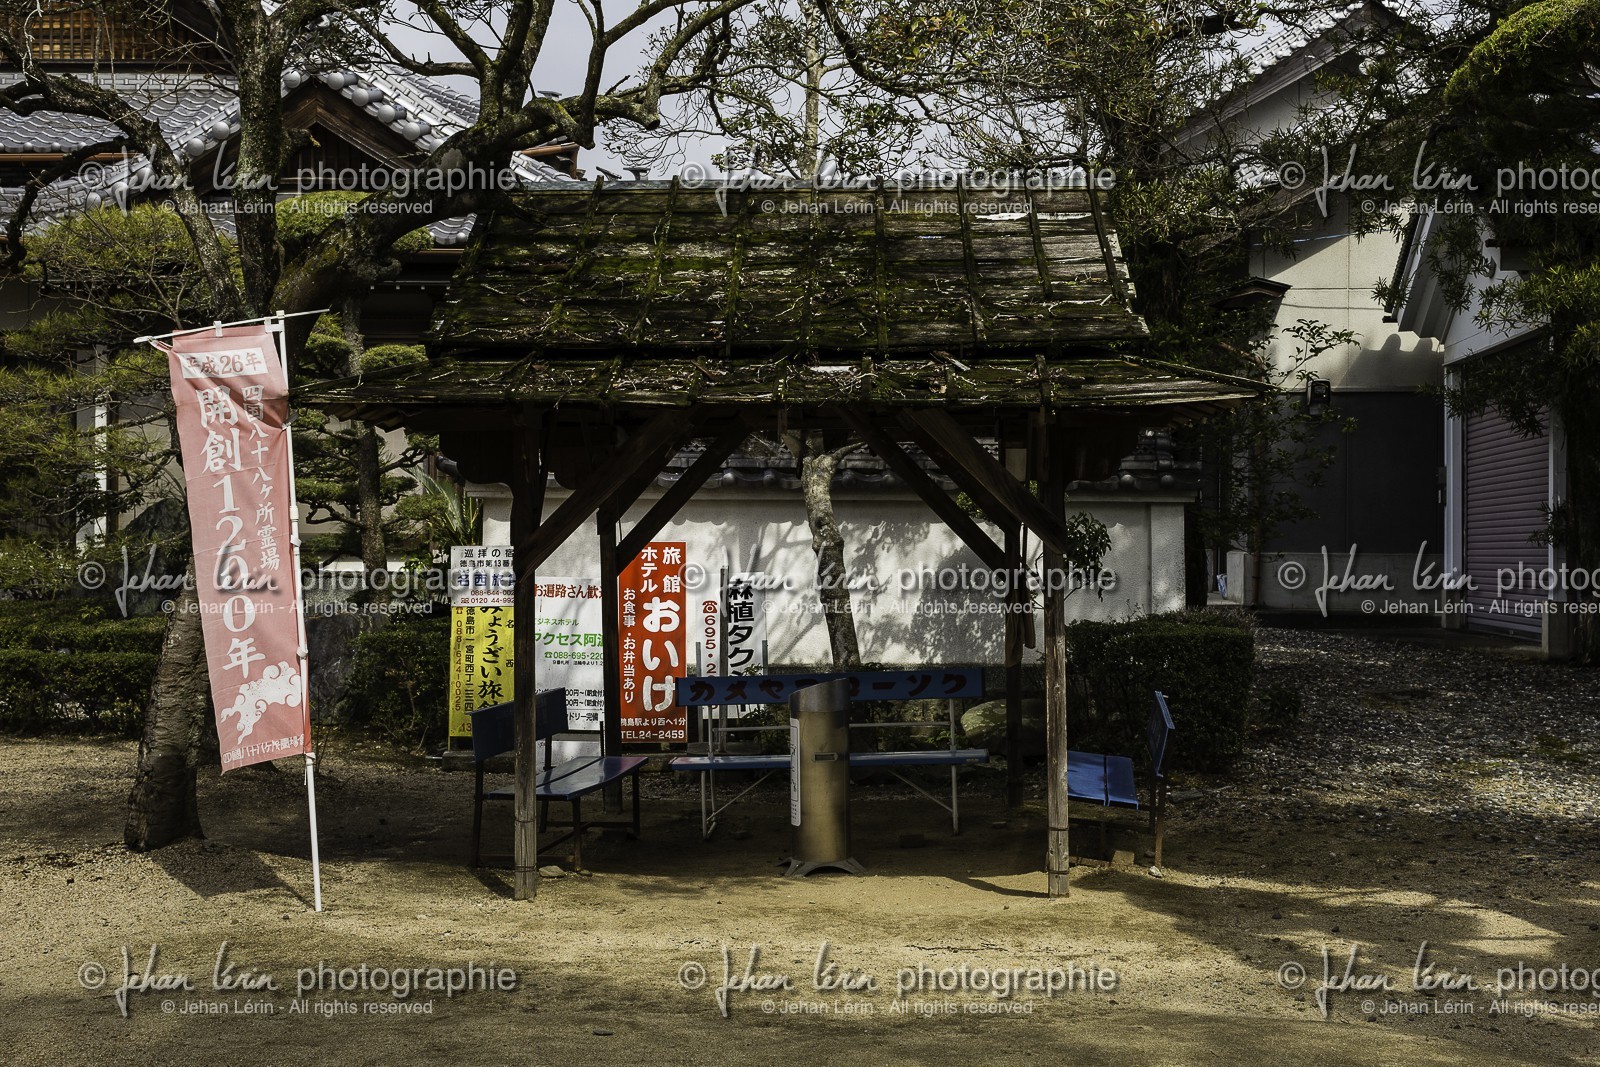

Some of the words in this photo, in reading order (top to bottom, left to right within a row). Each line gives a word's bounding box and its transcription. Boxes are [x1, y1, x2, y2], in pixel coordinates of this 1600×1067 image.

[186, 352, 262, 375] 平成26年
[195, 384, 266, 679] 開創1200年
[460, 559, 514, 568] 徳島市第13番
[464, 548, 514, 558] 巡拝の宿
[640, 546, 659, 594] ホテル
[662, 546, 681, 594] 旅館
[534, 583, 602, 599] お遍路さん歓
[642, 596, 680, 712] おいけ
[728, 578, 754, 712] 森植タク
[568, 712, 598, 722] ドリー完備
[621, 729, 685, 739] TEL24-2459
